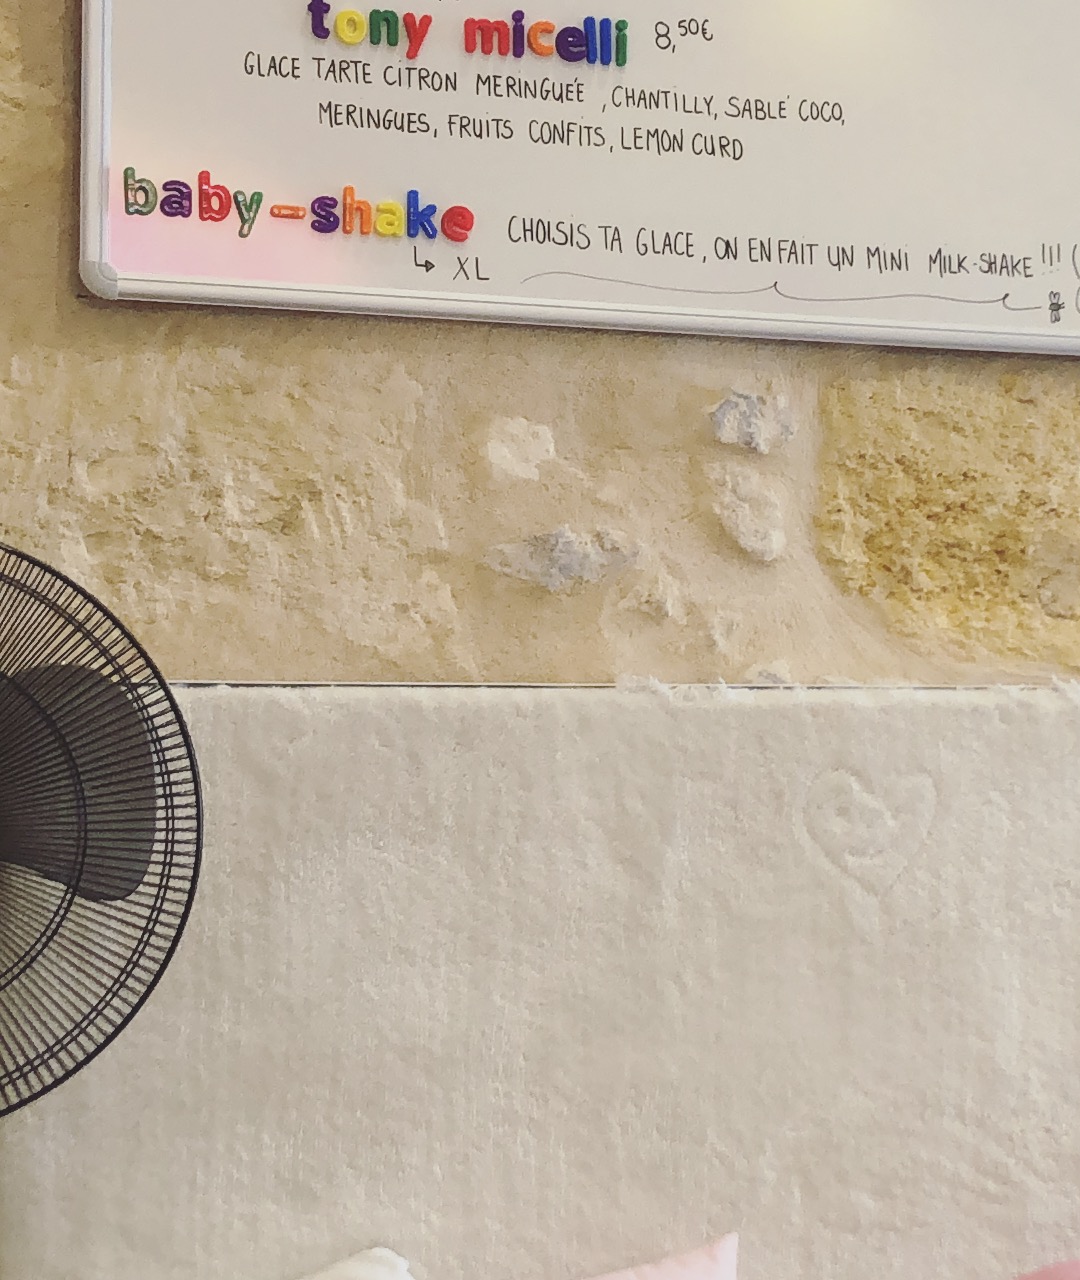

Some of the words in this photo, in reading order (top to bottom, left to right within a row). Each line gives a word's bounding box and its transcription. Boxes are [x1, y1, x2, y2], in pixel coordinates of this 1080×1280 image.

[464, 10, 628, 68] micelli
[244, 51, 300, 79] GLACE
[312, 57, 372, 84] TARTE
[383, 60, 457, 92] CITRON
[318, 101, 438, 138] MERINGUES,
[448, 112, 514, 140] FRUITS
[620, 127, 684, 156] LEMON
[691, 132, 743, 160] CURD
[452, 256, 490, 281] XL
[508, 215, 591, 250] CHOISIS
[598, 225, 623, 254] TA
[714, 236, 738, 261] ON
[827, 244, 854, 271] UN
[866, 245, 911, 274] MINI
